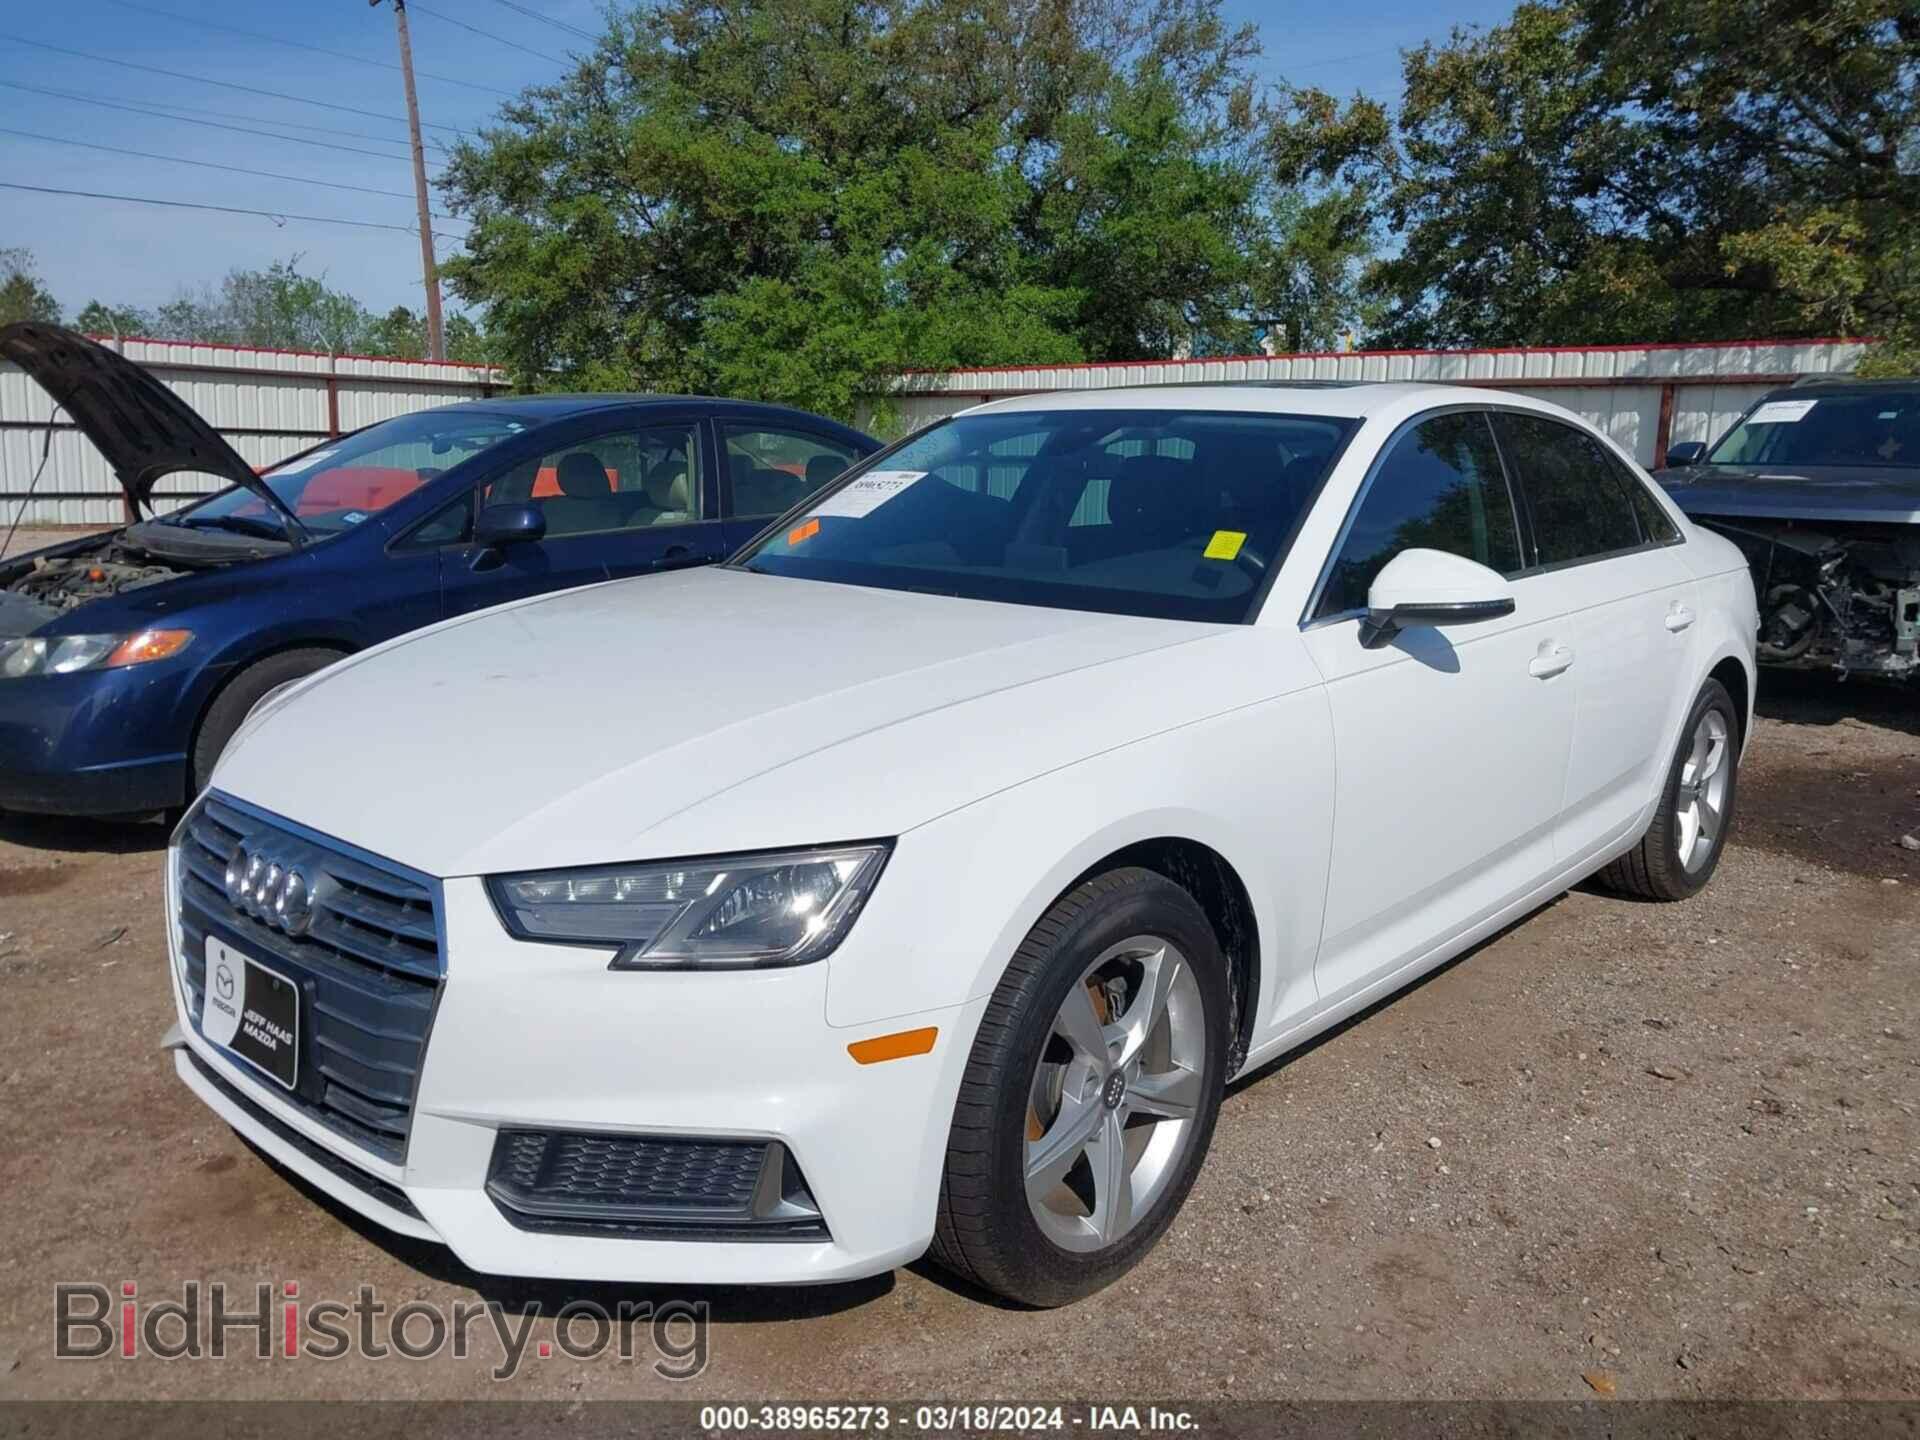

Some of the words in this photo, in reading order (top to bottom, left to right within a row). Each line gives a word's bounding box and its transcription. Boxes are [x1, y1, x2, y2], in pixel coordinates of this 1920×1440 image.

[243, 1021, 277, 1051] MAZDA
[244, 1009, 266, 1026] JEFF
[266, 1019, 293, 1046] HAAS
